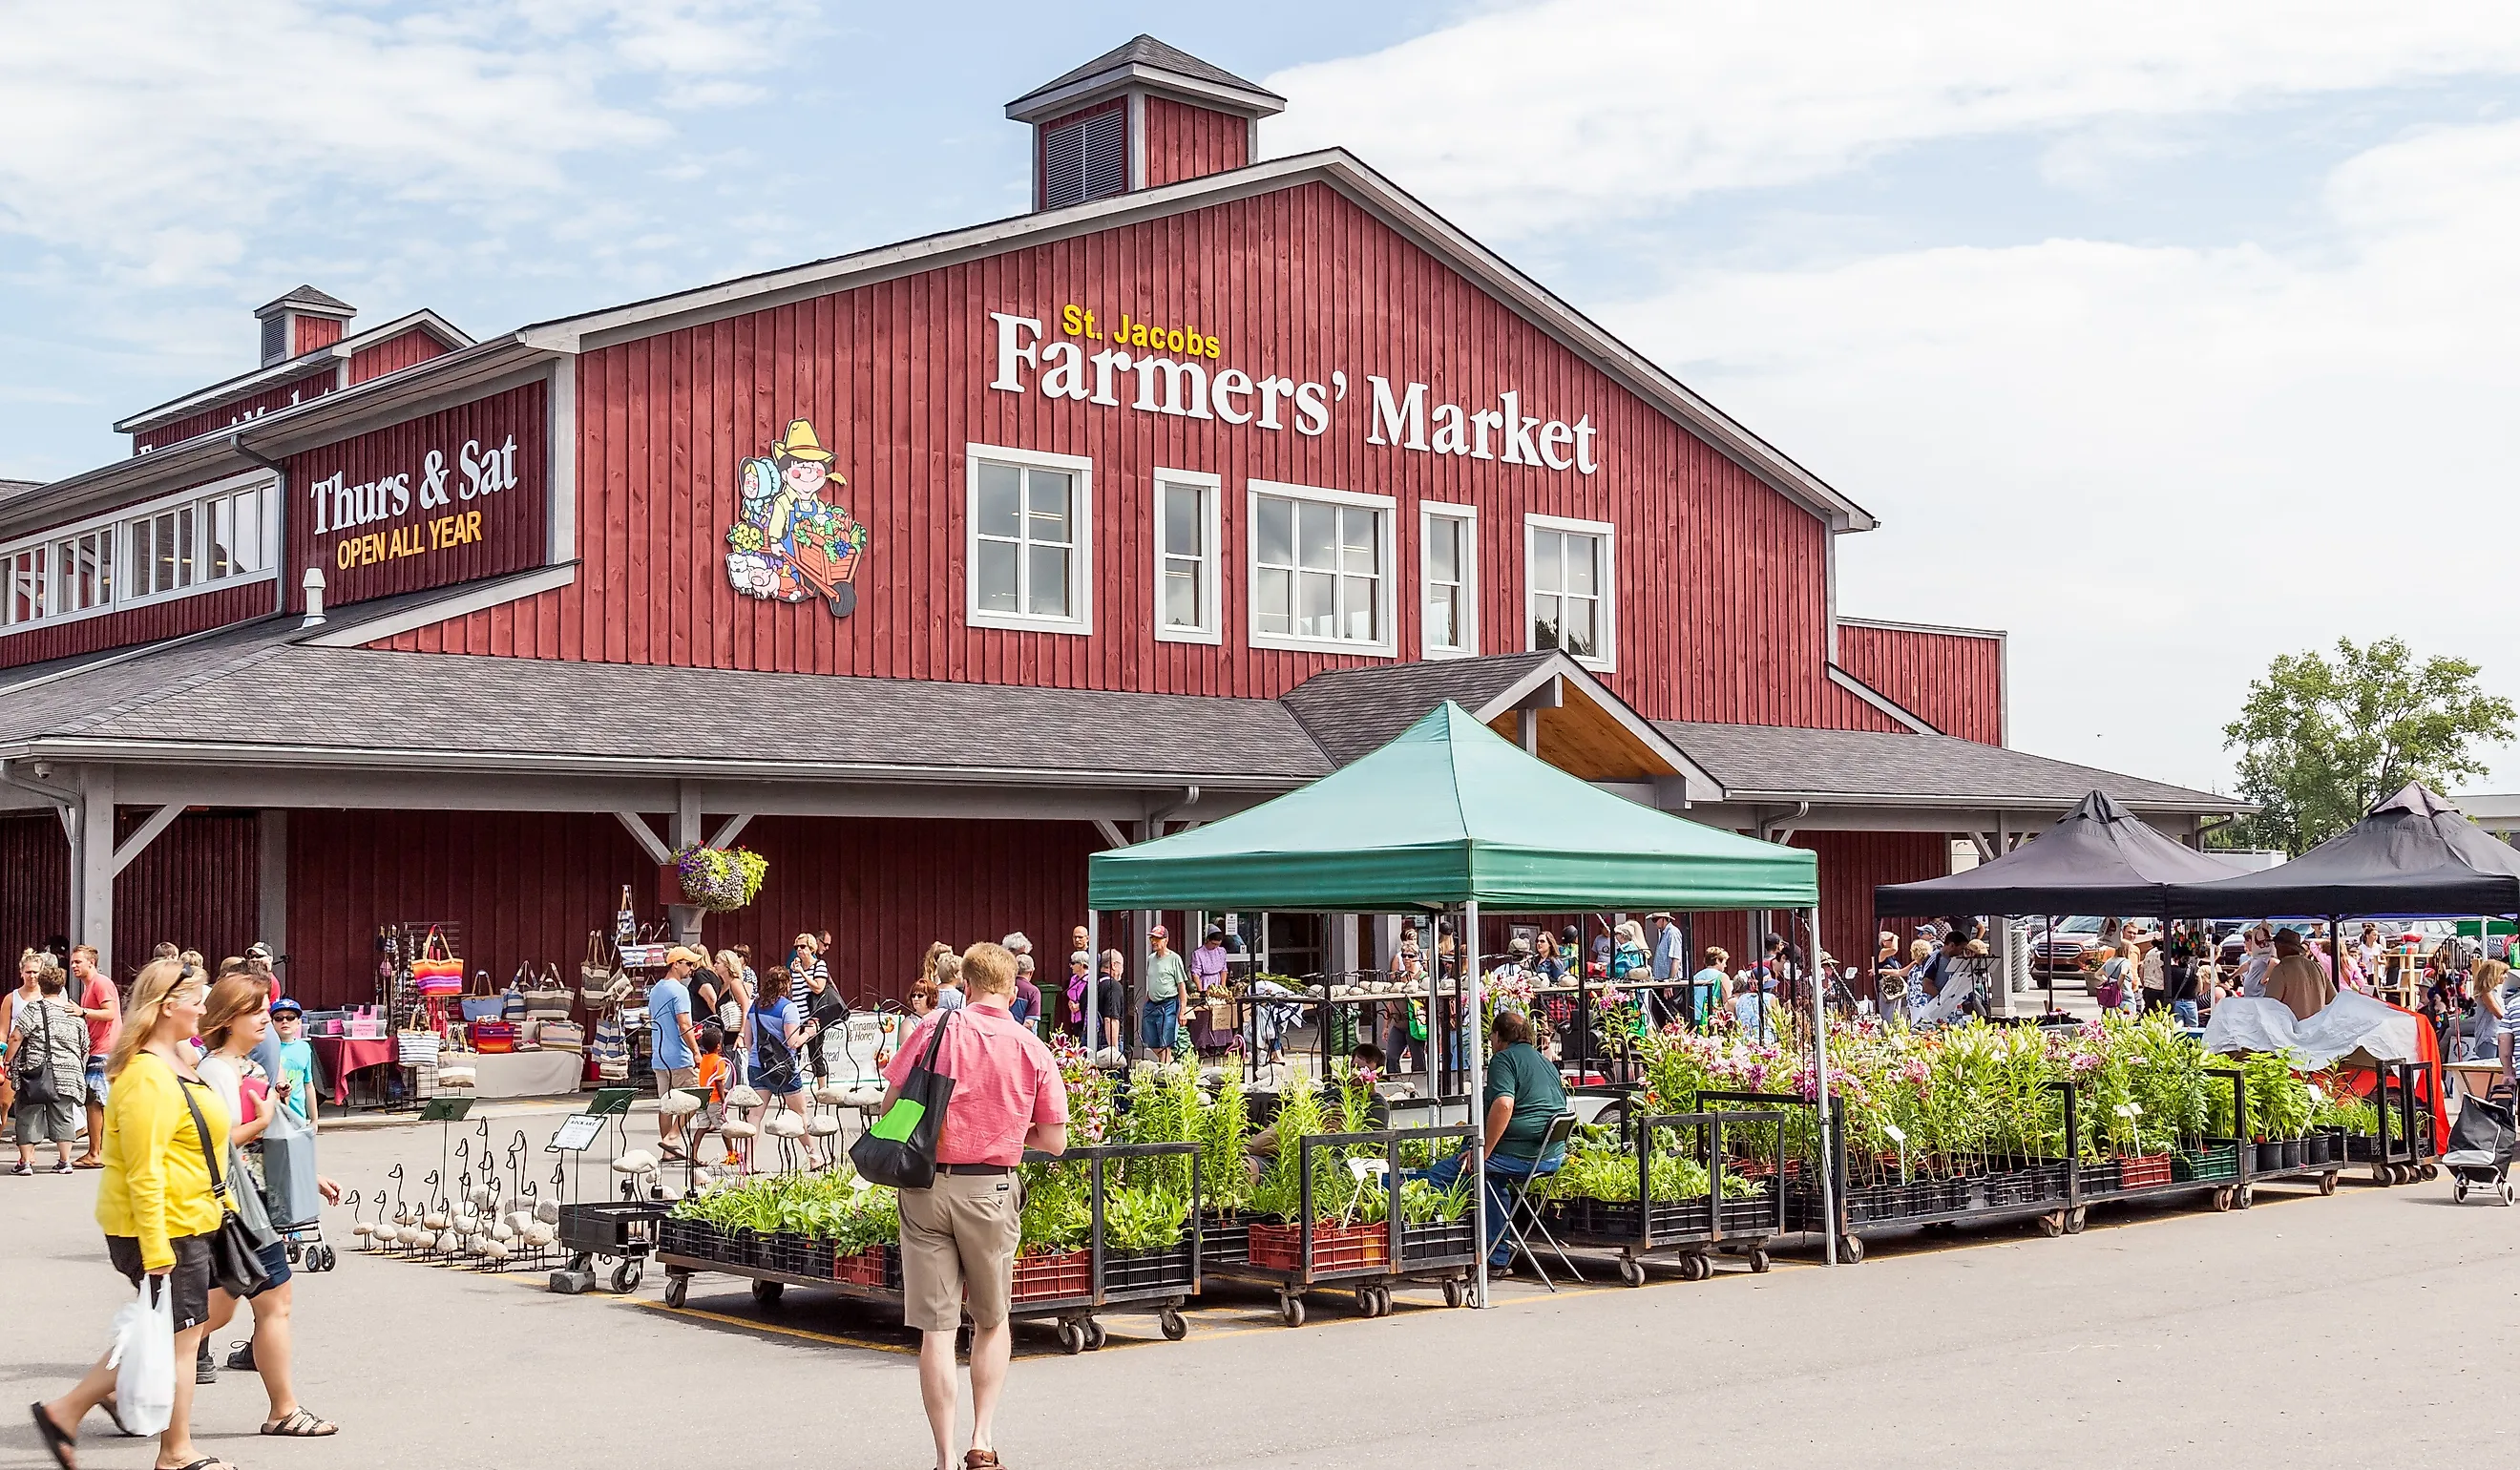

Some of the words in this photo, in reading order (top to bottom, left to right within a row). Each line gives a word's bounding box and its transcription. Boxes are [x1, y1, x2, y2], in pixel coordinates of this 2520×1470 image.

[1062, 304, 1102, 341] St.
[1113, 314, 1221, 359] Jacobs
[989, 311, 1347, 437] Farmers’
[1366, 374, 1598, 474] Market
[310, 470, 410, 536] Thurs
[419, 450, 451, 510] &
[459, 433, 518, 500] Sat
[337, 531, 386, 571] OPEN
[388, 523, 426, 560] ALL
[429, 510, 483, 552] YEAR
[854, 1031, 875, 1045] Honey
